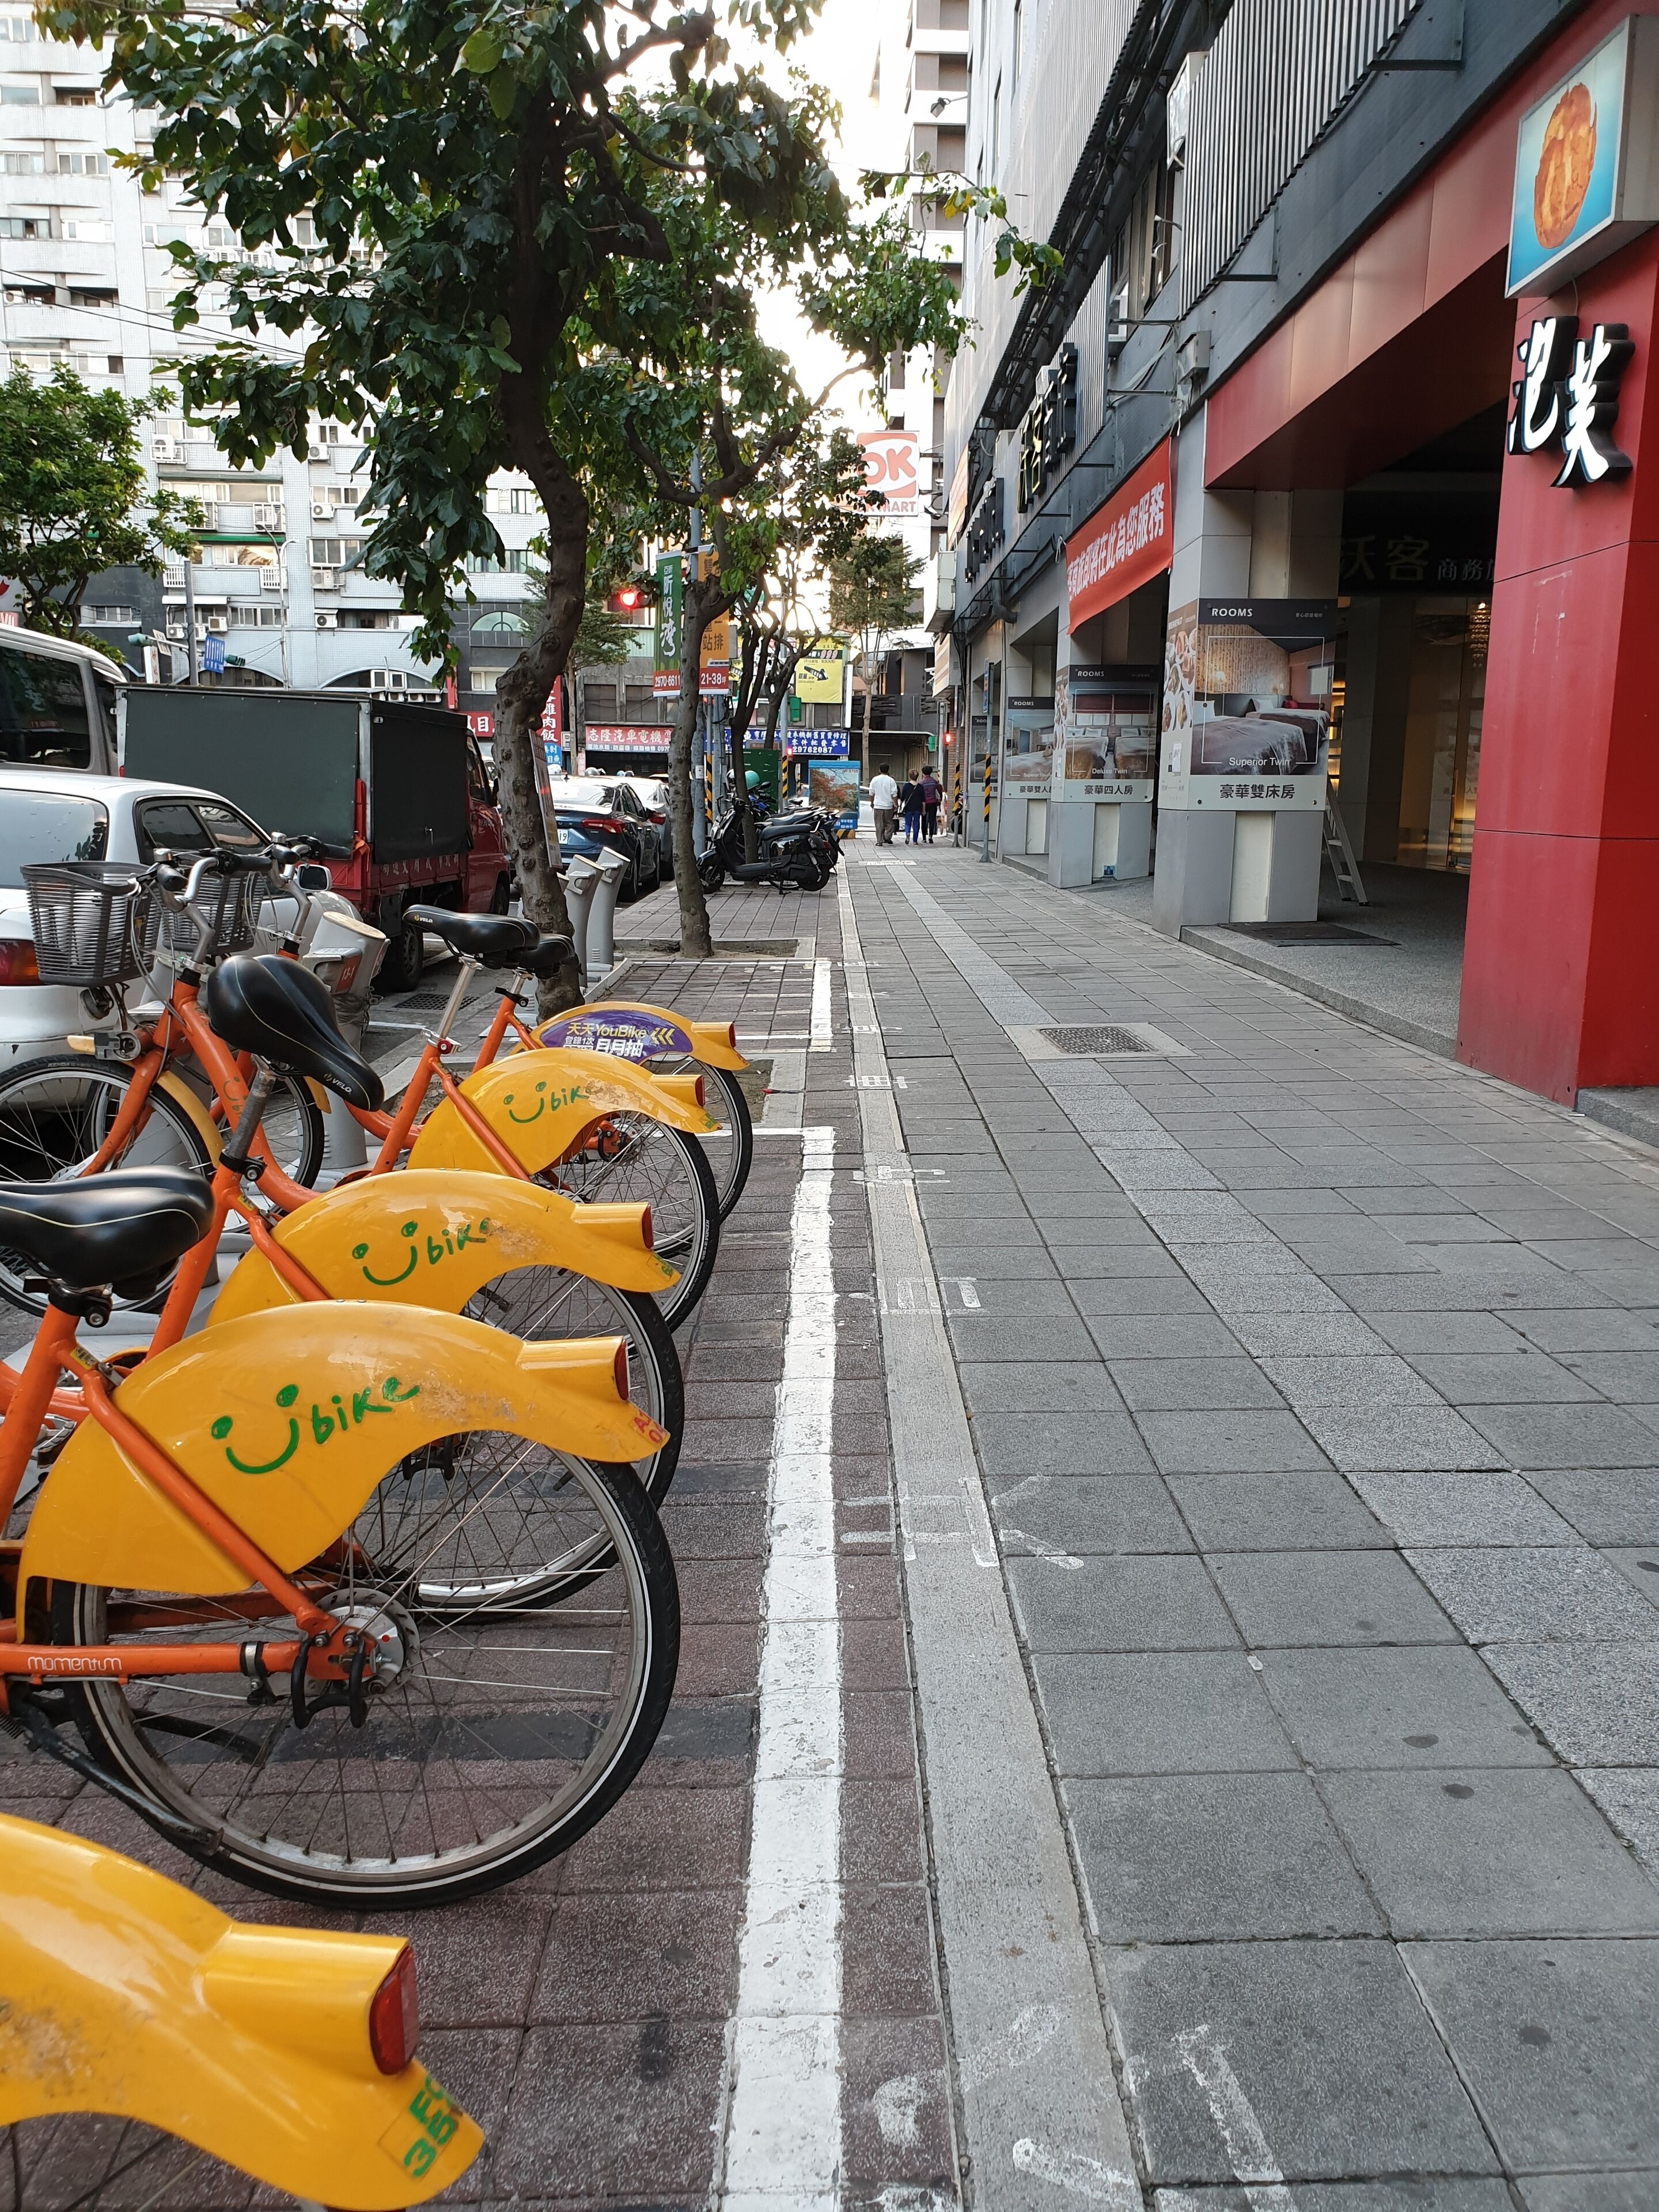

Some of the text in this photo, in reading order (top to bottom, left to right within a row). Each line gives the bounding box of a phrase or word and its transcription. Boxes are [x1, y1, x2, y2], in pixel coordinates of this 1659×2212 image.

[1212, 608, 1253, 617] ROOMS
[655, 672, 680, 687] 2970-6611
[1229, 757, 1291, 767] Superior Twin
[1084, 785, 1133, 795] 豪華四人房
[1219, 784, 1295, 799] 豪華雙床房
[332, 1078, 352, 1093] VELO
[28, 1656, 122, 1671] momentum
